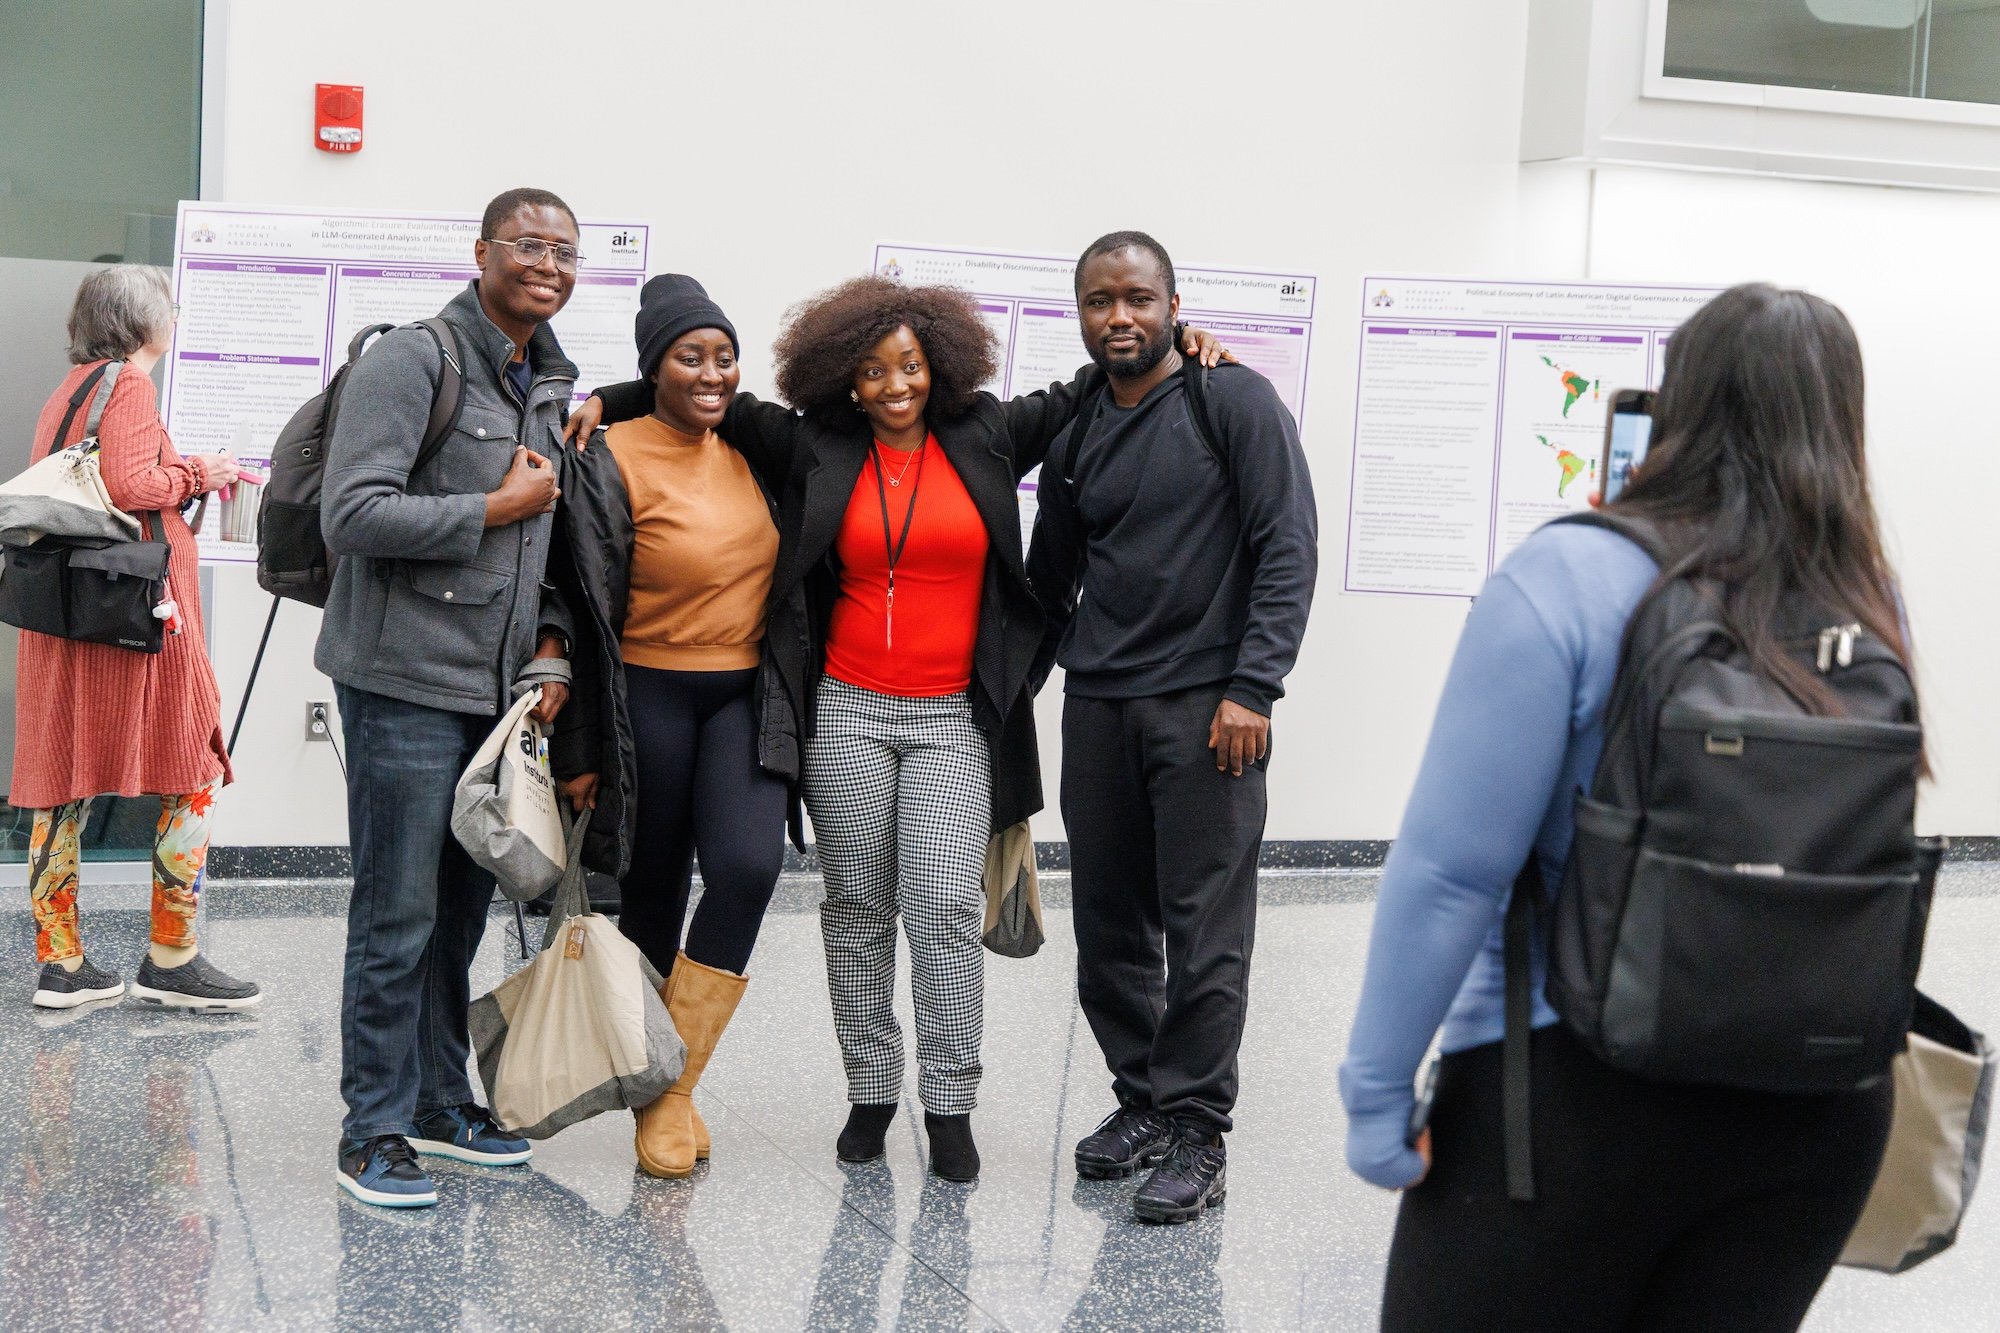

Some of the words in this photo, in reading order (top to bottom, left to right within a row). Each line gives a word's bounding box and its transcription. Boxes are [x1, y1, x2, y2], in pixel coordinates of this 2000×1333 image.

[330, 142, 351, 150] FIRE
[321, 219, 370, 230] Algorithmic
[371, 220, 404, 229] Erasure:
[406, 222, 450, 232] Evaluating
[451, 223, 482, 232] Cultura
[321, 231, 386, 240] LLM-Generated
[387, 233, 421, 243] Analysis
[236, 264, 276, 272] Introduction
[965, 260, 1000, 270] Disability
[1003, 263, 1058, 273] Discrimination
[411, 272, 441, 280] Examples
[1196, 277, 1238, 287] Regulatory
[1240, 280, 1276, 289] Solutions
[1498, 290, 1533, 299] Economy
[1606, 294, 1631, 302] Digital
[1633, 294, 1680, 302] Governance
[1682, 296, 1712, 305] Adoptio
[1212, 322, 1246, 330] Framework
[1258, 325, 1290, 333] Legislation
[247, 355, 280, 363] Statement
[175, 410, 208, 418] Algorithmic
[238, 459, 263, 467] odology
[119, 638, 146, 647] EPSON
